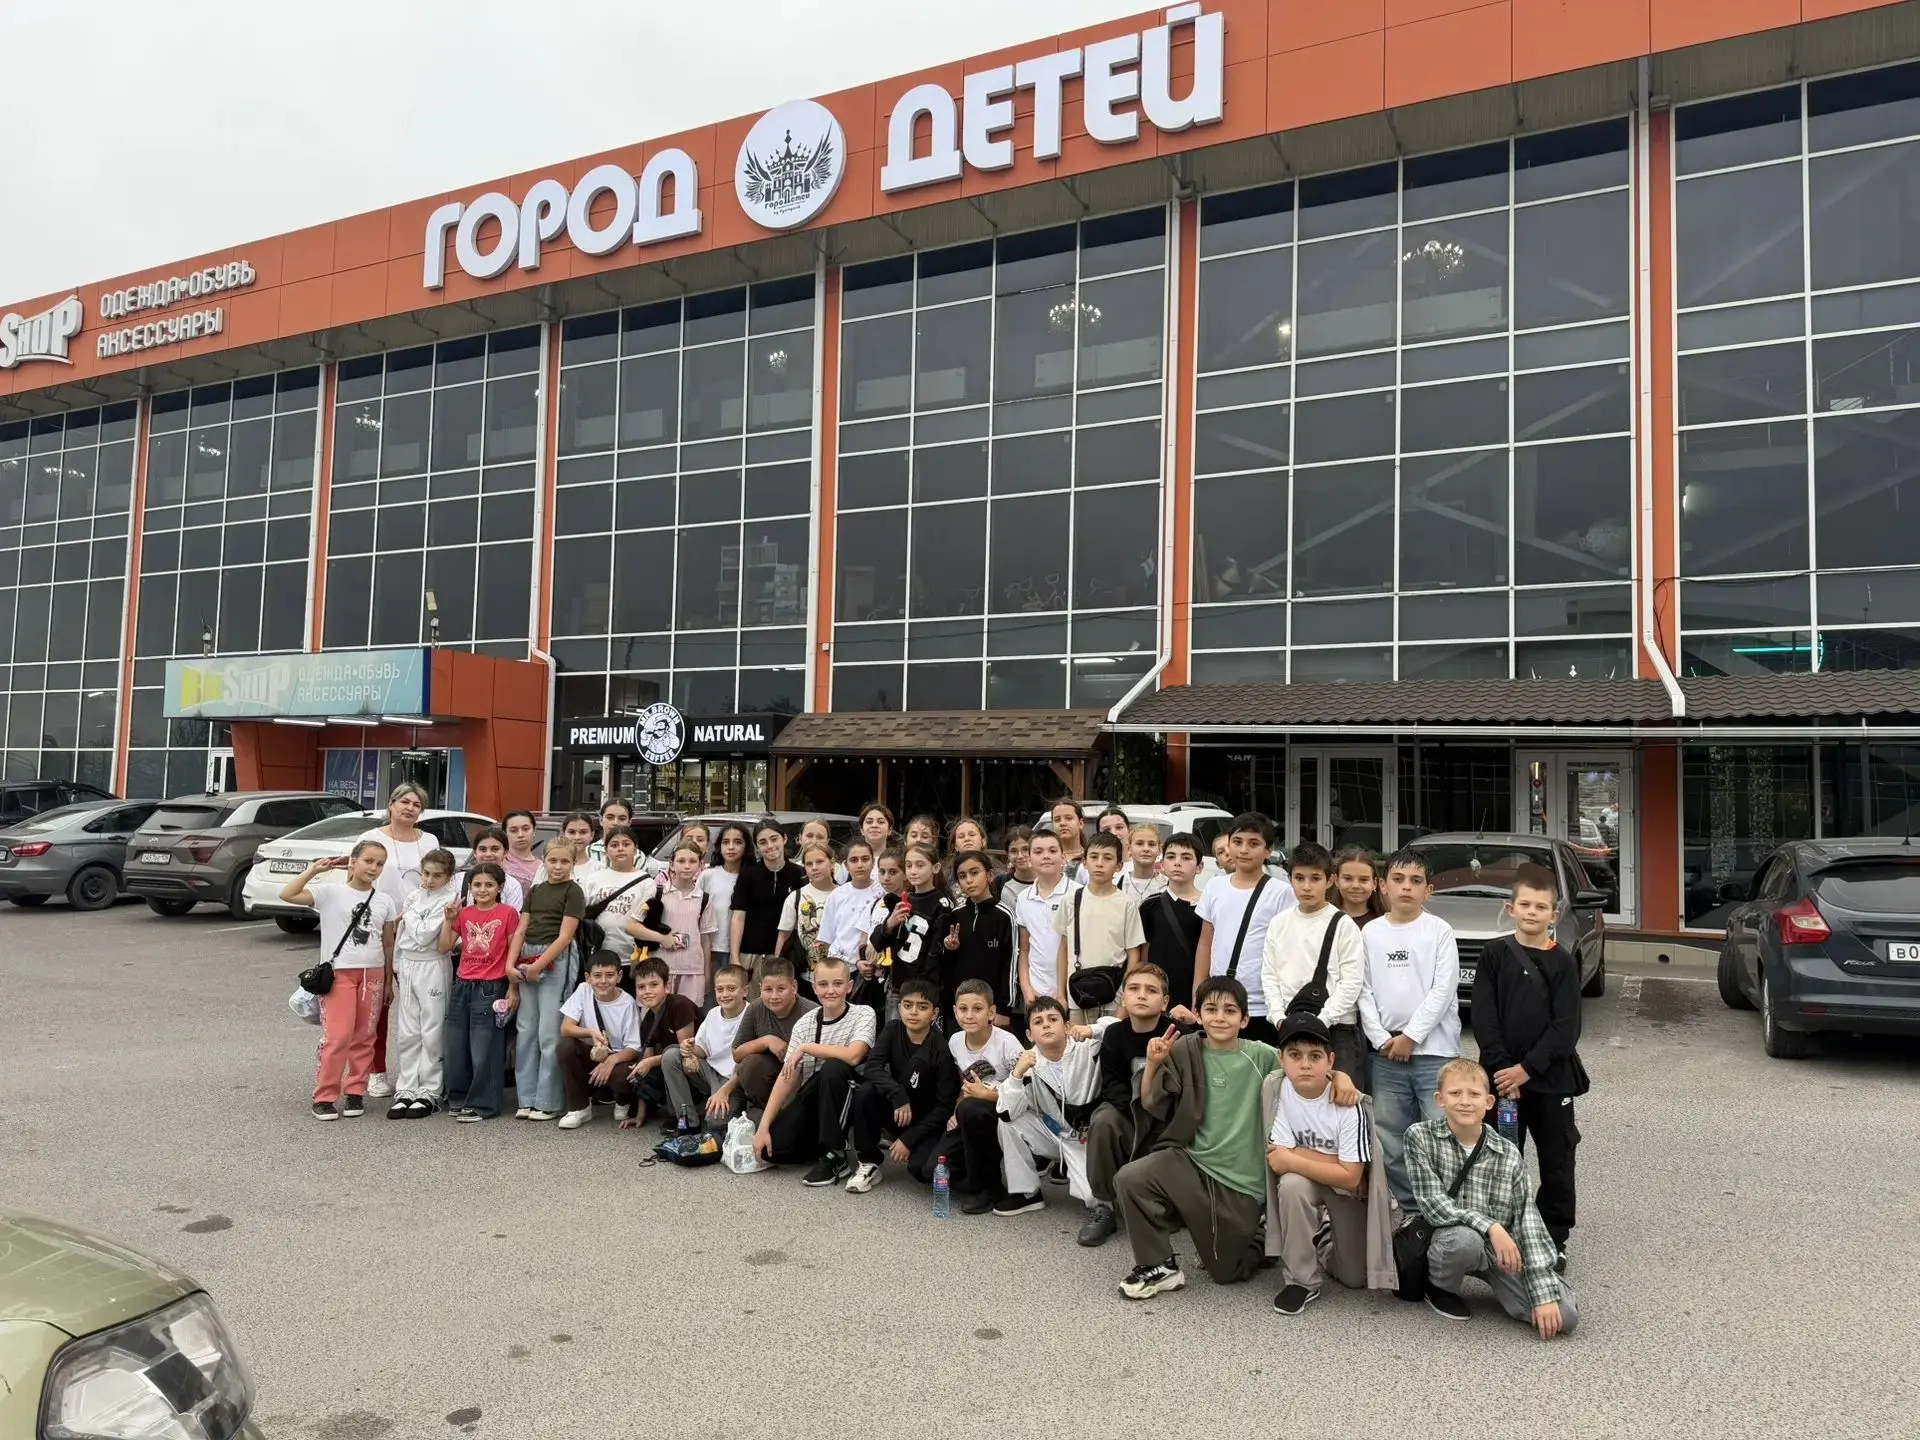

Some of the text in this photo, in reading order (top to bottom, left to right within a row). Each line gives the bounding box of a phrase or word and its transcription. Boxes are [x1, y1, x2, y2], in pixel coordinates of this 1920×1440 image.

[423, 2, 1224, 289] ГОРОД ДЕТЕЙ
[97, 307, 224, 359] АКСЕССУАРЫ
[297, 685, 381, 702] АКСЕССУАРЫ
[639, 705, 680, 727] MR BROWN
[570, 727, 635, 745] PREMIUM
[694, 724, 765, 742] NATURAL
[644, 749, 675, 762] COFFEE
[340, 780, 358, 789] ВЕСЬ
